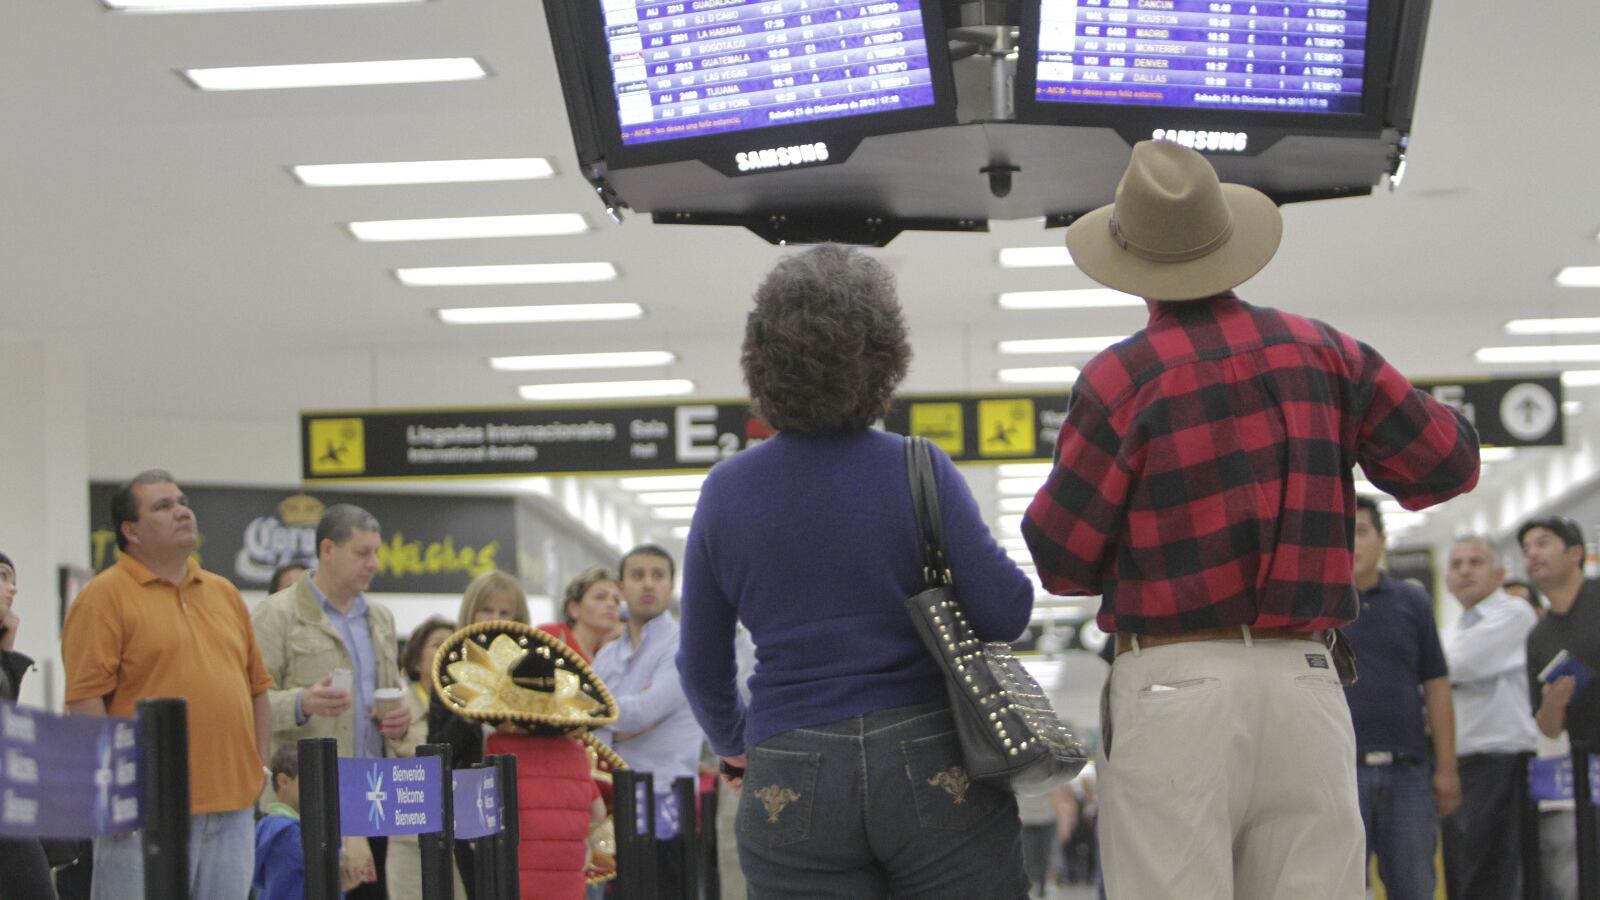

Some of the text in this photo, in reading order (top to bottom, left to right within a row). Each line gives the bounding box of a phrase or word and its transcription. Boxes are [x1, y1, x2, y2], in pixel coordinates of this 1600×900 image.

[697, 30, 708, 38] LA
[709, 26, 742, 37] HABANA
[801, 15, 811, 24] E1
[860, 7, 867, 16] A
[868, 4, 898, 14] TIEMPO
[1250, 6, 1257, 14] A
[1307, 8, 1314, 17] A
[1316, 9, 1346, 18] TIEMPO
[862, 22, 870, 31] A
[870, 18, 901, 29] TIEMPO
[1136, 13, 1178, 24] HOUSTON
[1248, 20, 1256, 29] E
[1306, 23, 1314, 32] A
[1315, 24, 1345, 33] TIEMPO
[1136, 29, 1169, 38] MADRID
[1248, 34, 1255, 43] E
[1305, 37, 1313, 46] A
[1314, 38, 1345, 48] TIEMPO
[702, 54, 750, 67] GUATEMALA
[864, 36, 872, 45] A
[872, 32, 903, 43] TIEMPO
[1135, 44, 1186, 54] MONTERREY
[1246, 49, 1254, 58] A
[1304, 52, 1312, 61] A
[1313, 53, 1343, 62] TIEMPO
[704, 72, 719, 82] LAS
[721, 68, 748, 80] VEGAS
[867, 50, 874, 60] A
[874, 47, 905, 58] TIEMPO
[1134, 59, 1168, 67] DENVER
[1246, 64, 1253, 72] E
[1303, 67, 1311, 75] A
[1312, 67, 1342, 77] TIEMPO
[706, 84, 740, 96] TIJUANA
[812, 73, 819, 82] A
[869, 65, 876, 74] A
[877, 62, 907, 72] TIEMPO
[1133, 74, 1167, 83] DALLAS
[1245, 78, 1252, 87] E
[1303, 82, 1310, 90] A
[1311, 82, 1341, 92] TIEMPO
[708, 101, 726, 111] NEW
[728, 98, 750, 109] YORK
[871, 80, 878, 89] A
[879, 76, 909, 88] TIEMPO
[1241, 95, 1276, 104] Diciembre
[795, 108, 803, 116] 21
[805, 106, 813, 114] de
[814, 103, 848, 113] Diciembre
[850, 101, 858, 109] de
[860, 98, 875, 108] 2013
[736, 142, 828, 171] SAMSUNG
[408, 424, 484, 447] Llegadas
[486, 420, 615, 444] Internacionales
[392, 765, 425, 782] Bienvenido
[396, 788, 424, 803] Welcome
[395, 810, 426, 826] Bienvenue
